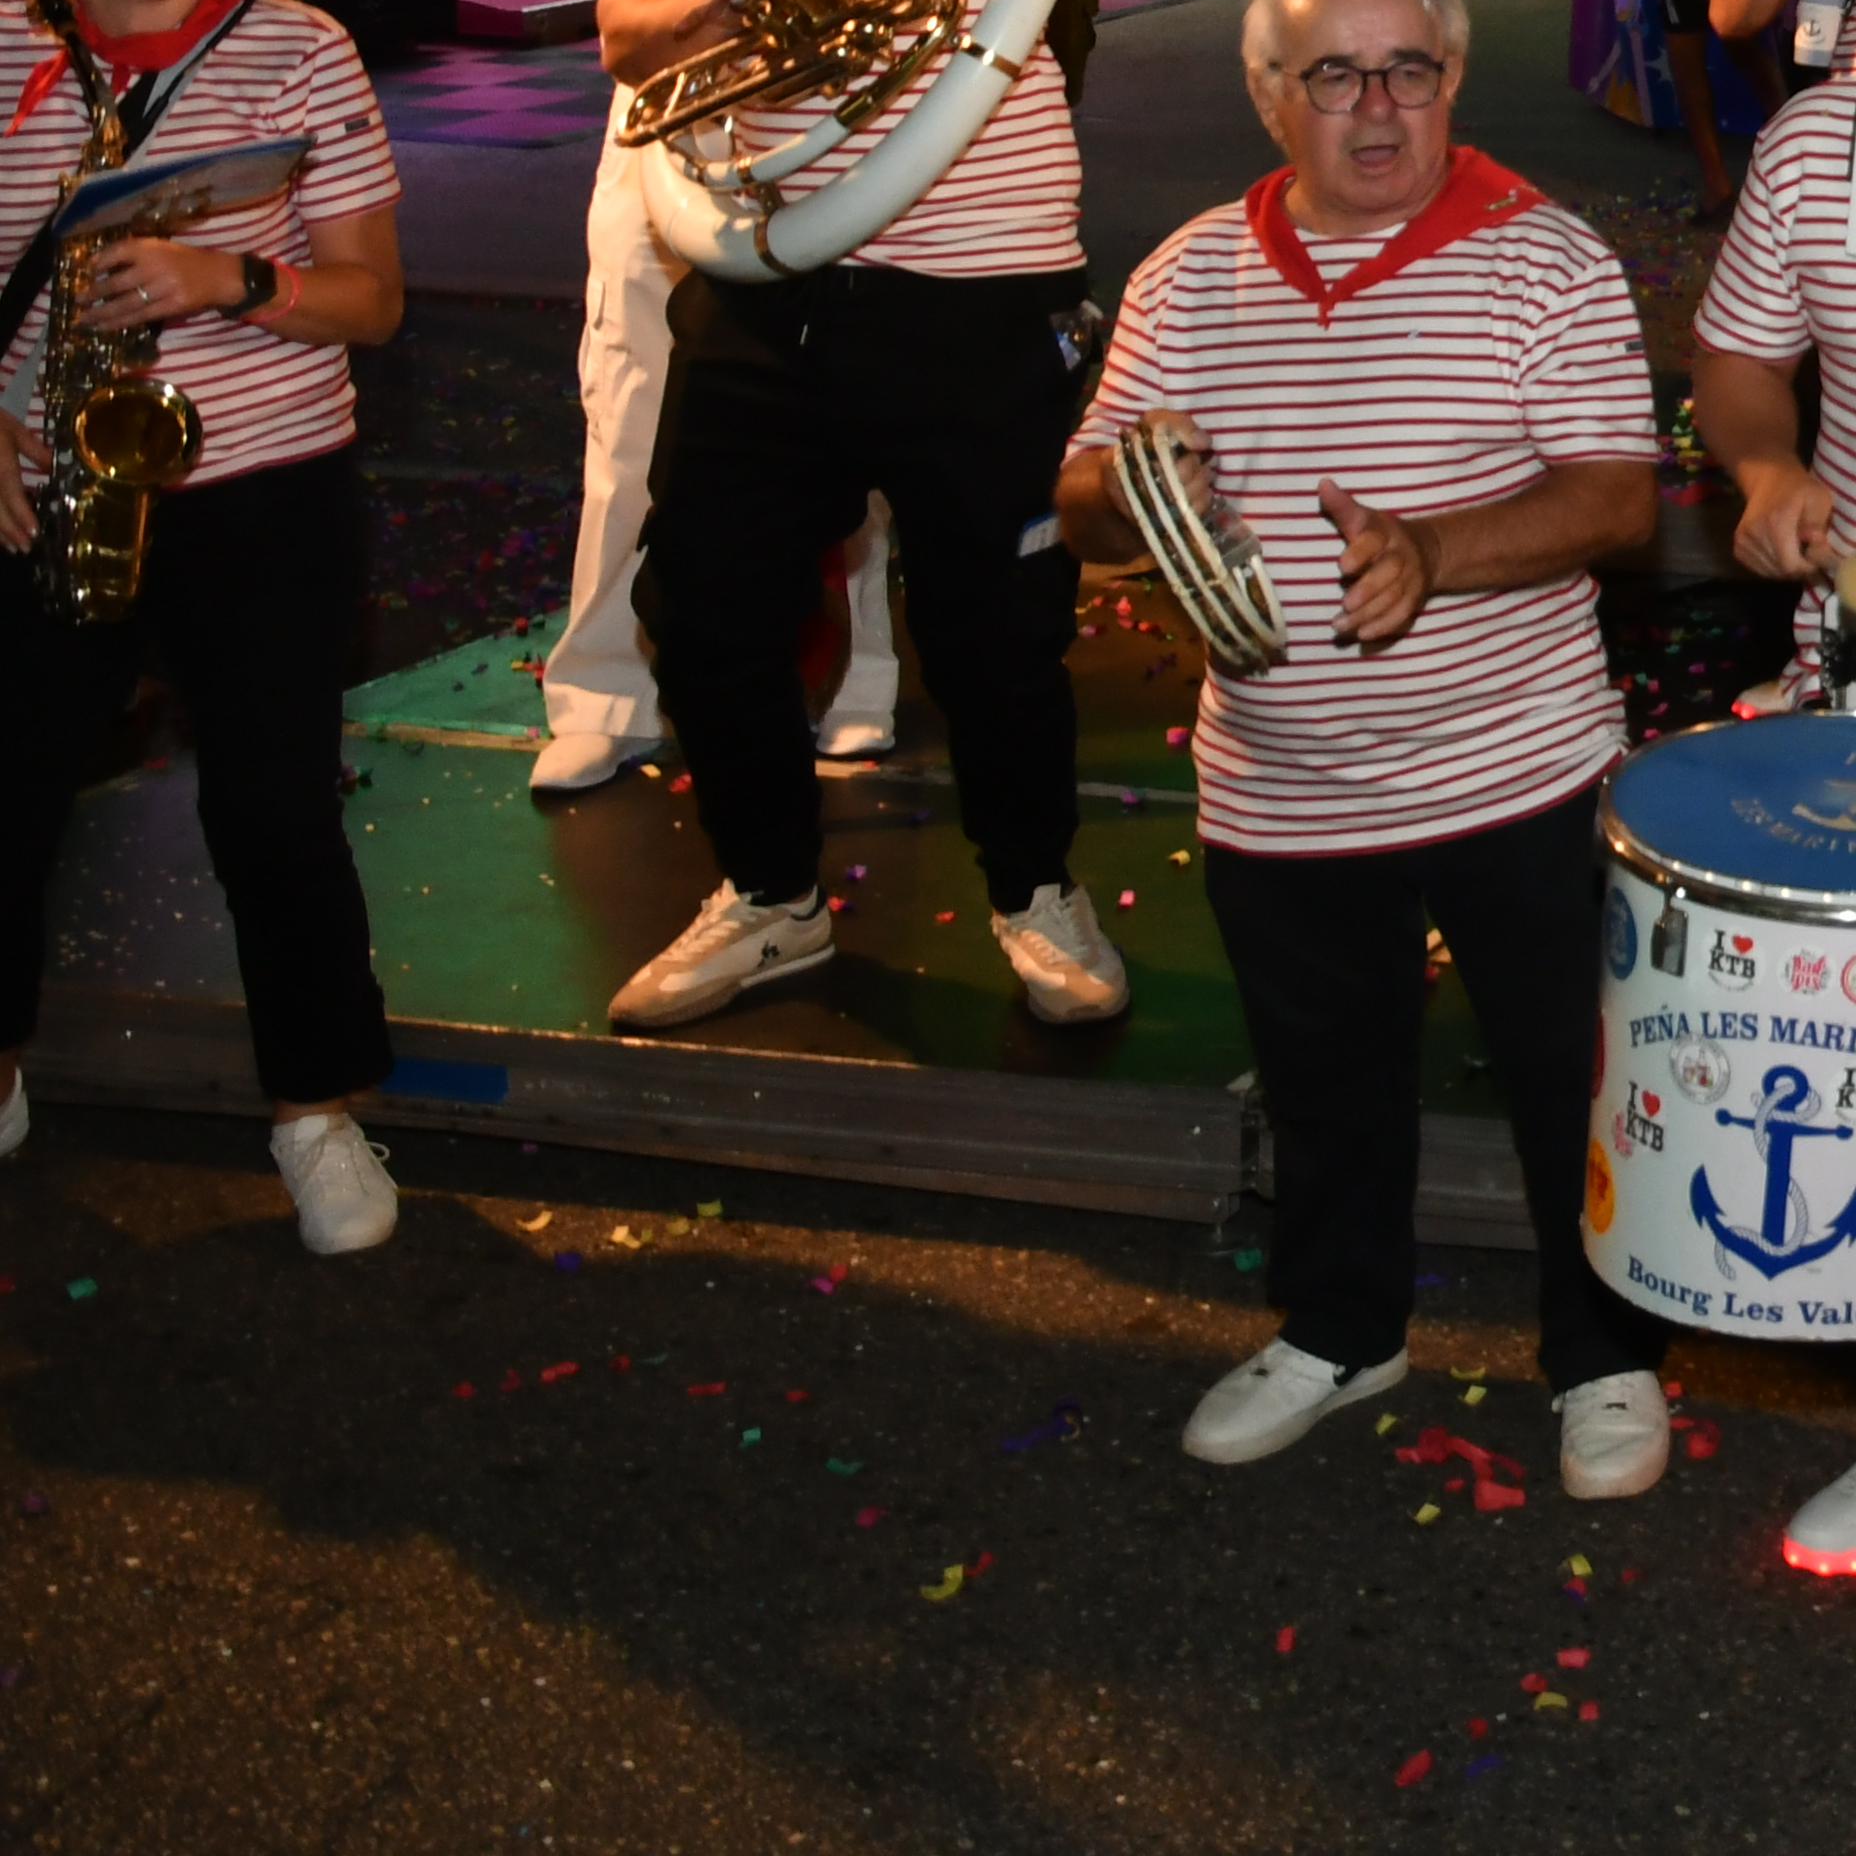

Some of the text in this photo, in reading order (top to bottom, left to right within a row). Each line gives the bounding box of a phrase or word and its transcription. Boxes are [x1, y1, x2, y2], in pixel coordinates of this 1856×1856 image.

[1708, 949, 1757, 979] KTB
[1628, 1005, 1691, 1049] PEÑA
[1701, 1011, 1759, 1041] LES
[1625, 1108, 1665, 1153] KTB
[1626, 1254, 1713, 1317] Bourg
[1722, 1291, 1784, 1323] Les
